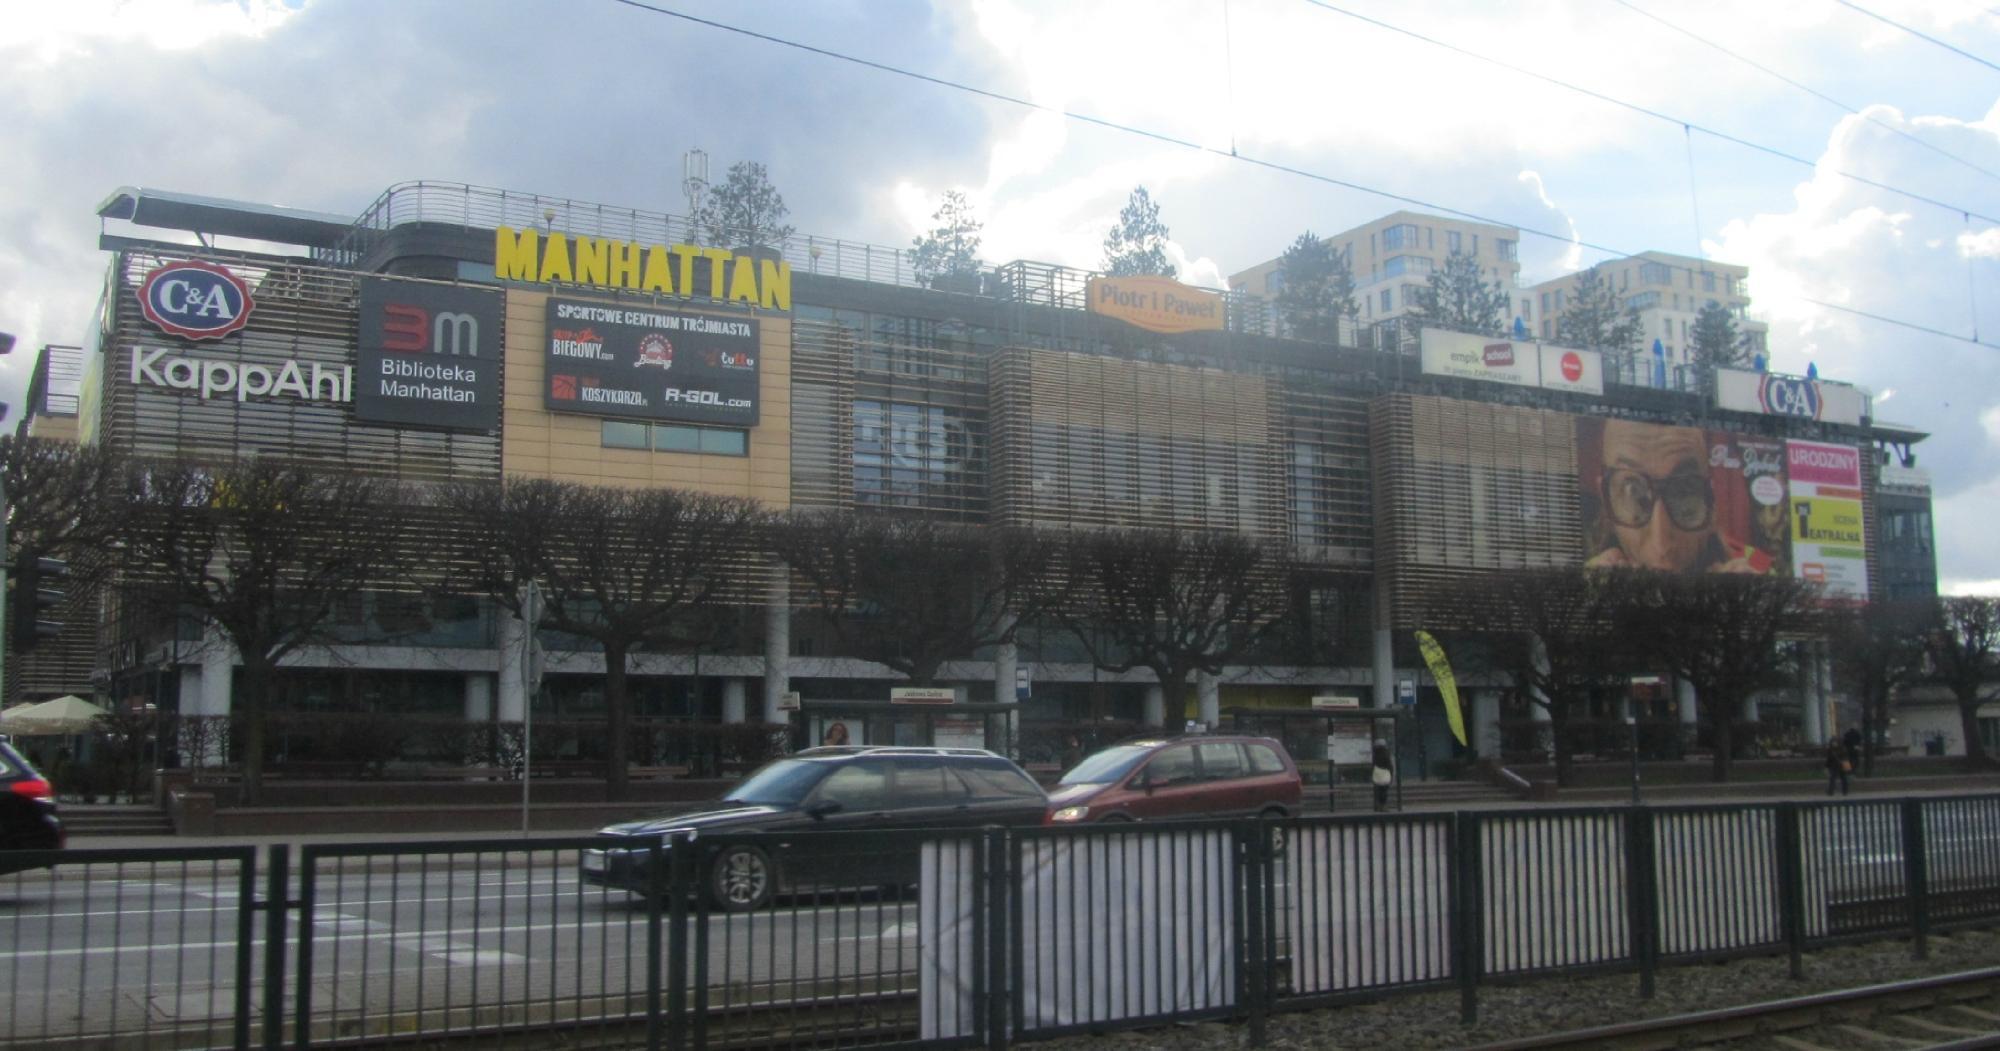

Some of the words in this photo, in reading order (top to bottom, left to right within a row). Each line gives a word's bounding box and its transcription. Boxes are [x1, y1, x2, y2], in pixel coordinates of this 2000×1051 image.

[495, 226, 791, 311] MANHATTAN
[159, 280, 234, 319] C&A
[1101, 284, 1146, 309] Piotr
[1151, 291, 1158, 310] i
[557, 304, 622, 324] SPORTOWE
[624, 311, 679, 331] CENTRUM
[681, 316, 751, 337] TRÓJMIASTA
[381, 358, 476, 382] Biblioteka
[1450, 350, 1479, 364] empik
[130, 346, 352, 402] KappAhl
[380, 379, 476, 402] Manhattan
[665, 387, 751, 408] R-GOL.com
[1769, 380, 1814, 416] C&A
[1790, 447, 1857, 470] URODZINY
